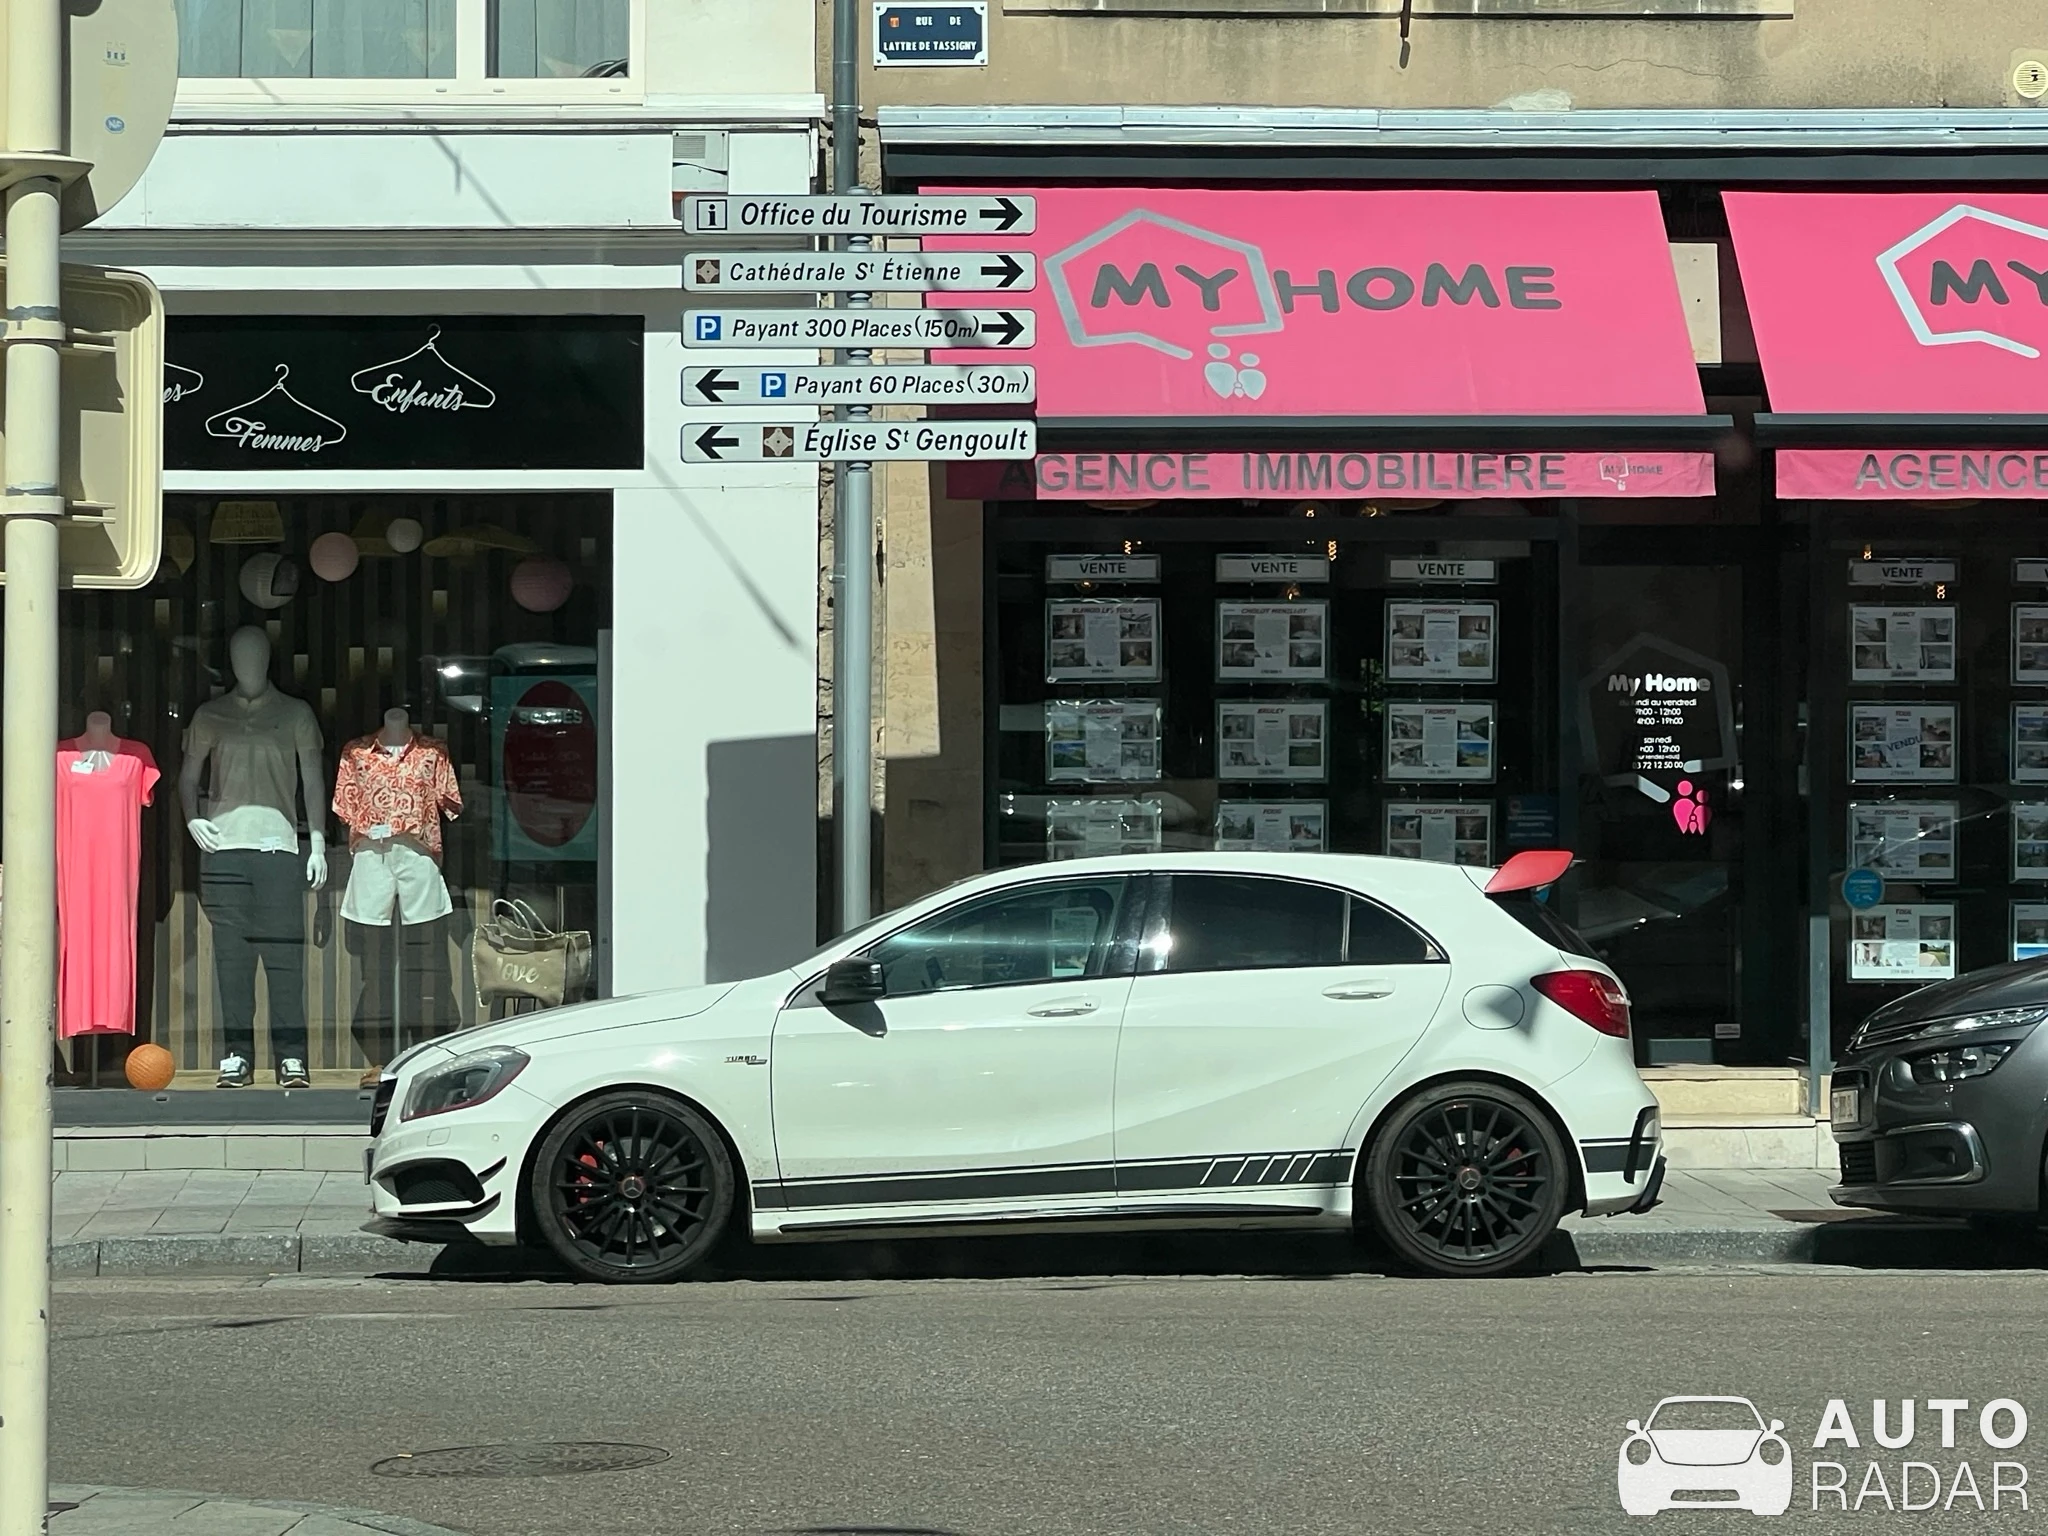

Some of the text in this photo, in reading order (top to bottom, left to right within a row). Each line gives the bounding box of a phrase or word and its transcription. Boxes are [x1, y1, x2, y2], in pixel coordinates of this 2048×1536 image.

[915, 16, 961, 26] RUE DE
[883, 41, 977, 51] LATTRE DE TASSIGNY
[740, 202, 968, 227] Office du Tourisme
[729, 258, 962, 282] Cathédrale St Étienne
[1091, 262, 1563, 315] MY HOME
[700, 318, 718, 336] P
[732, 318, 799, 343] Payant
[805, 318, 848, 338] 300
[371, 373, 465, 413] Enfants
[765, 376, 783, 395] P
[794, 376, 863, 399] Payant
[869, 376, 898, 395] 60
[226, 416, 324, 452] Femmes
[804, 423, 1029, 457] Église St Gengoult
[999, 452, 1567, 492] AGENCE IMMOBILIERE
[1627, 465, 1664, 475] HOME
[1079, 562, 1127, 574] VENTE
[1250, 562, 1298, 574] VENTE
[1417, 563, 1465, 576] VENTE
[1881, 567, 1924, 578] VENTE
[1607, 673, 1711, 697] My Home
[1662, 698, 1697, 706] vendredi
[1633, 717, 1655, 725] 4h00
[1661, 717, 1684, 725] 19h00
[1659, 708, 1682, 716] 12h00
[1658, 745, 1681, 753] 12h00
[1642, 762, 1652, 770] 72
[1654, 762, 1663, 770] 12
[1674, 761, 1684, 769] 00
[496, 956, 540, 984] love
